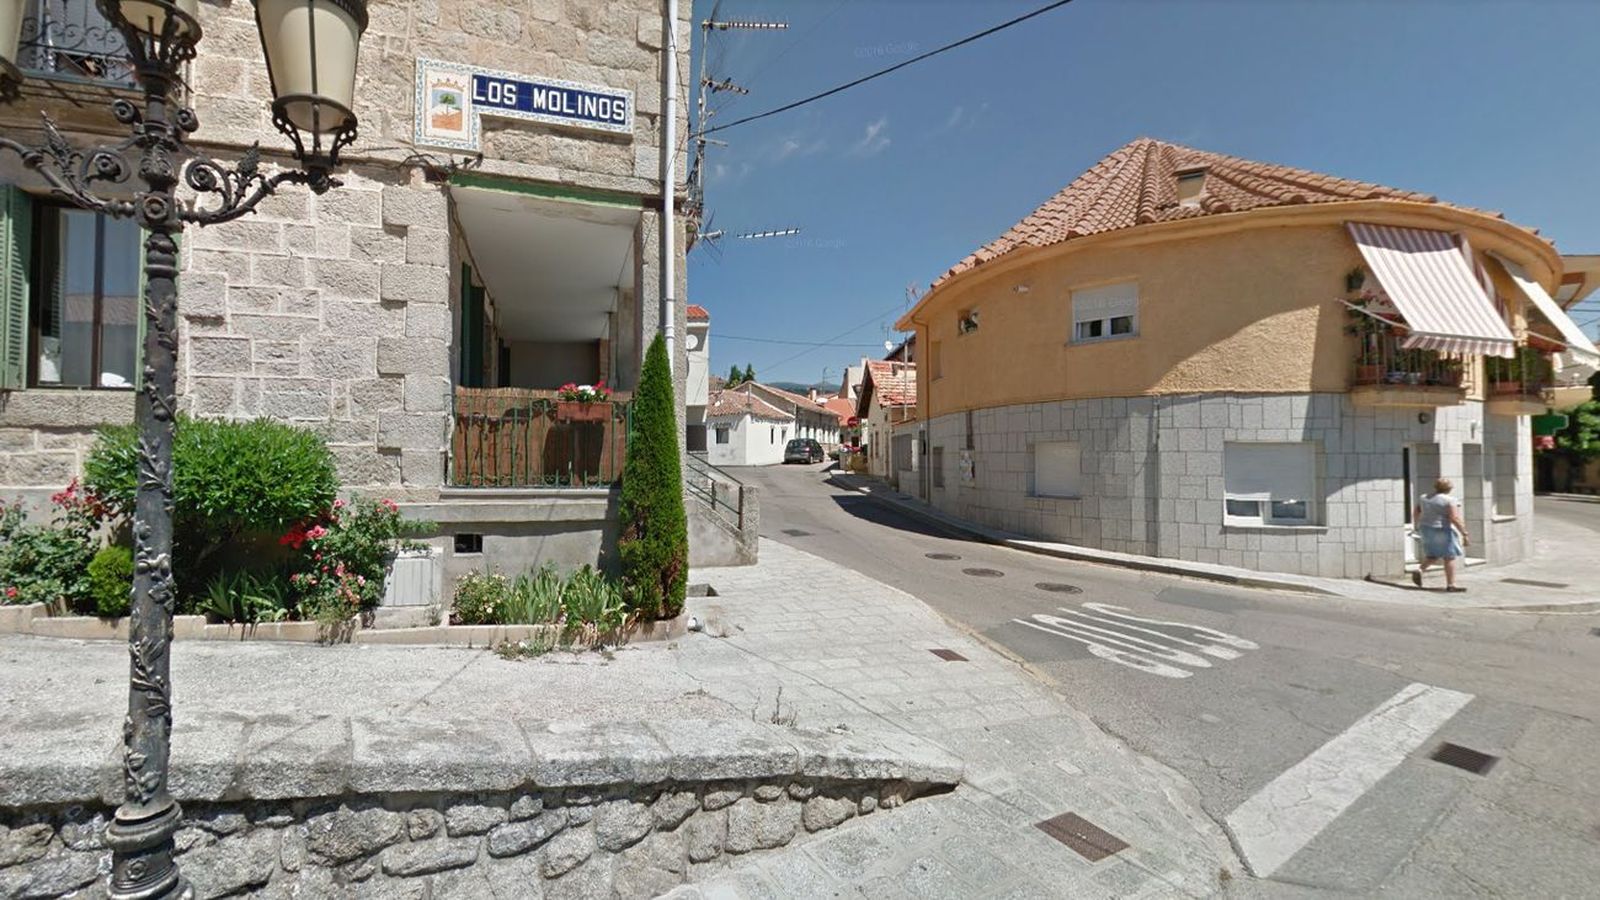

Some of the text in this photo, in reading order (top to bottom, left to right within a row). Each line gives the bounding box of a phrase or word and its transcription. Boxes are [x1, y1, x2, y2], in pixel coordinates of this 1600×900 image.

[472, 78, 626, 121] LOS MOLINOS
[1011, 601, 1260, 679] STOP
